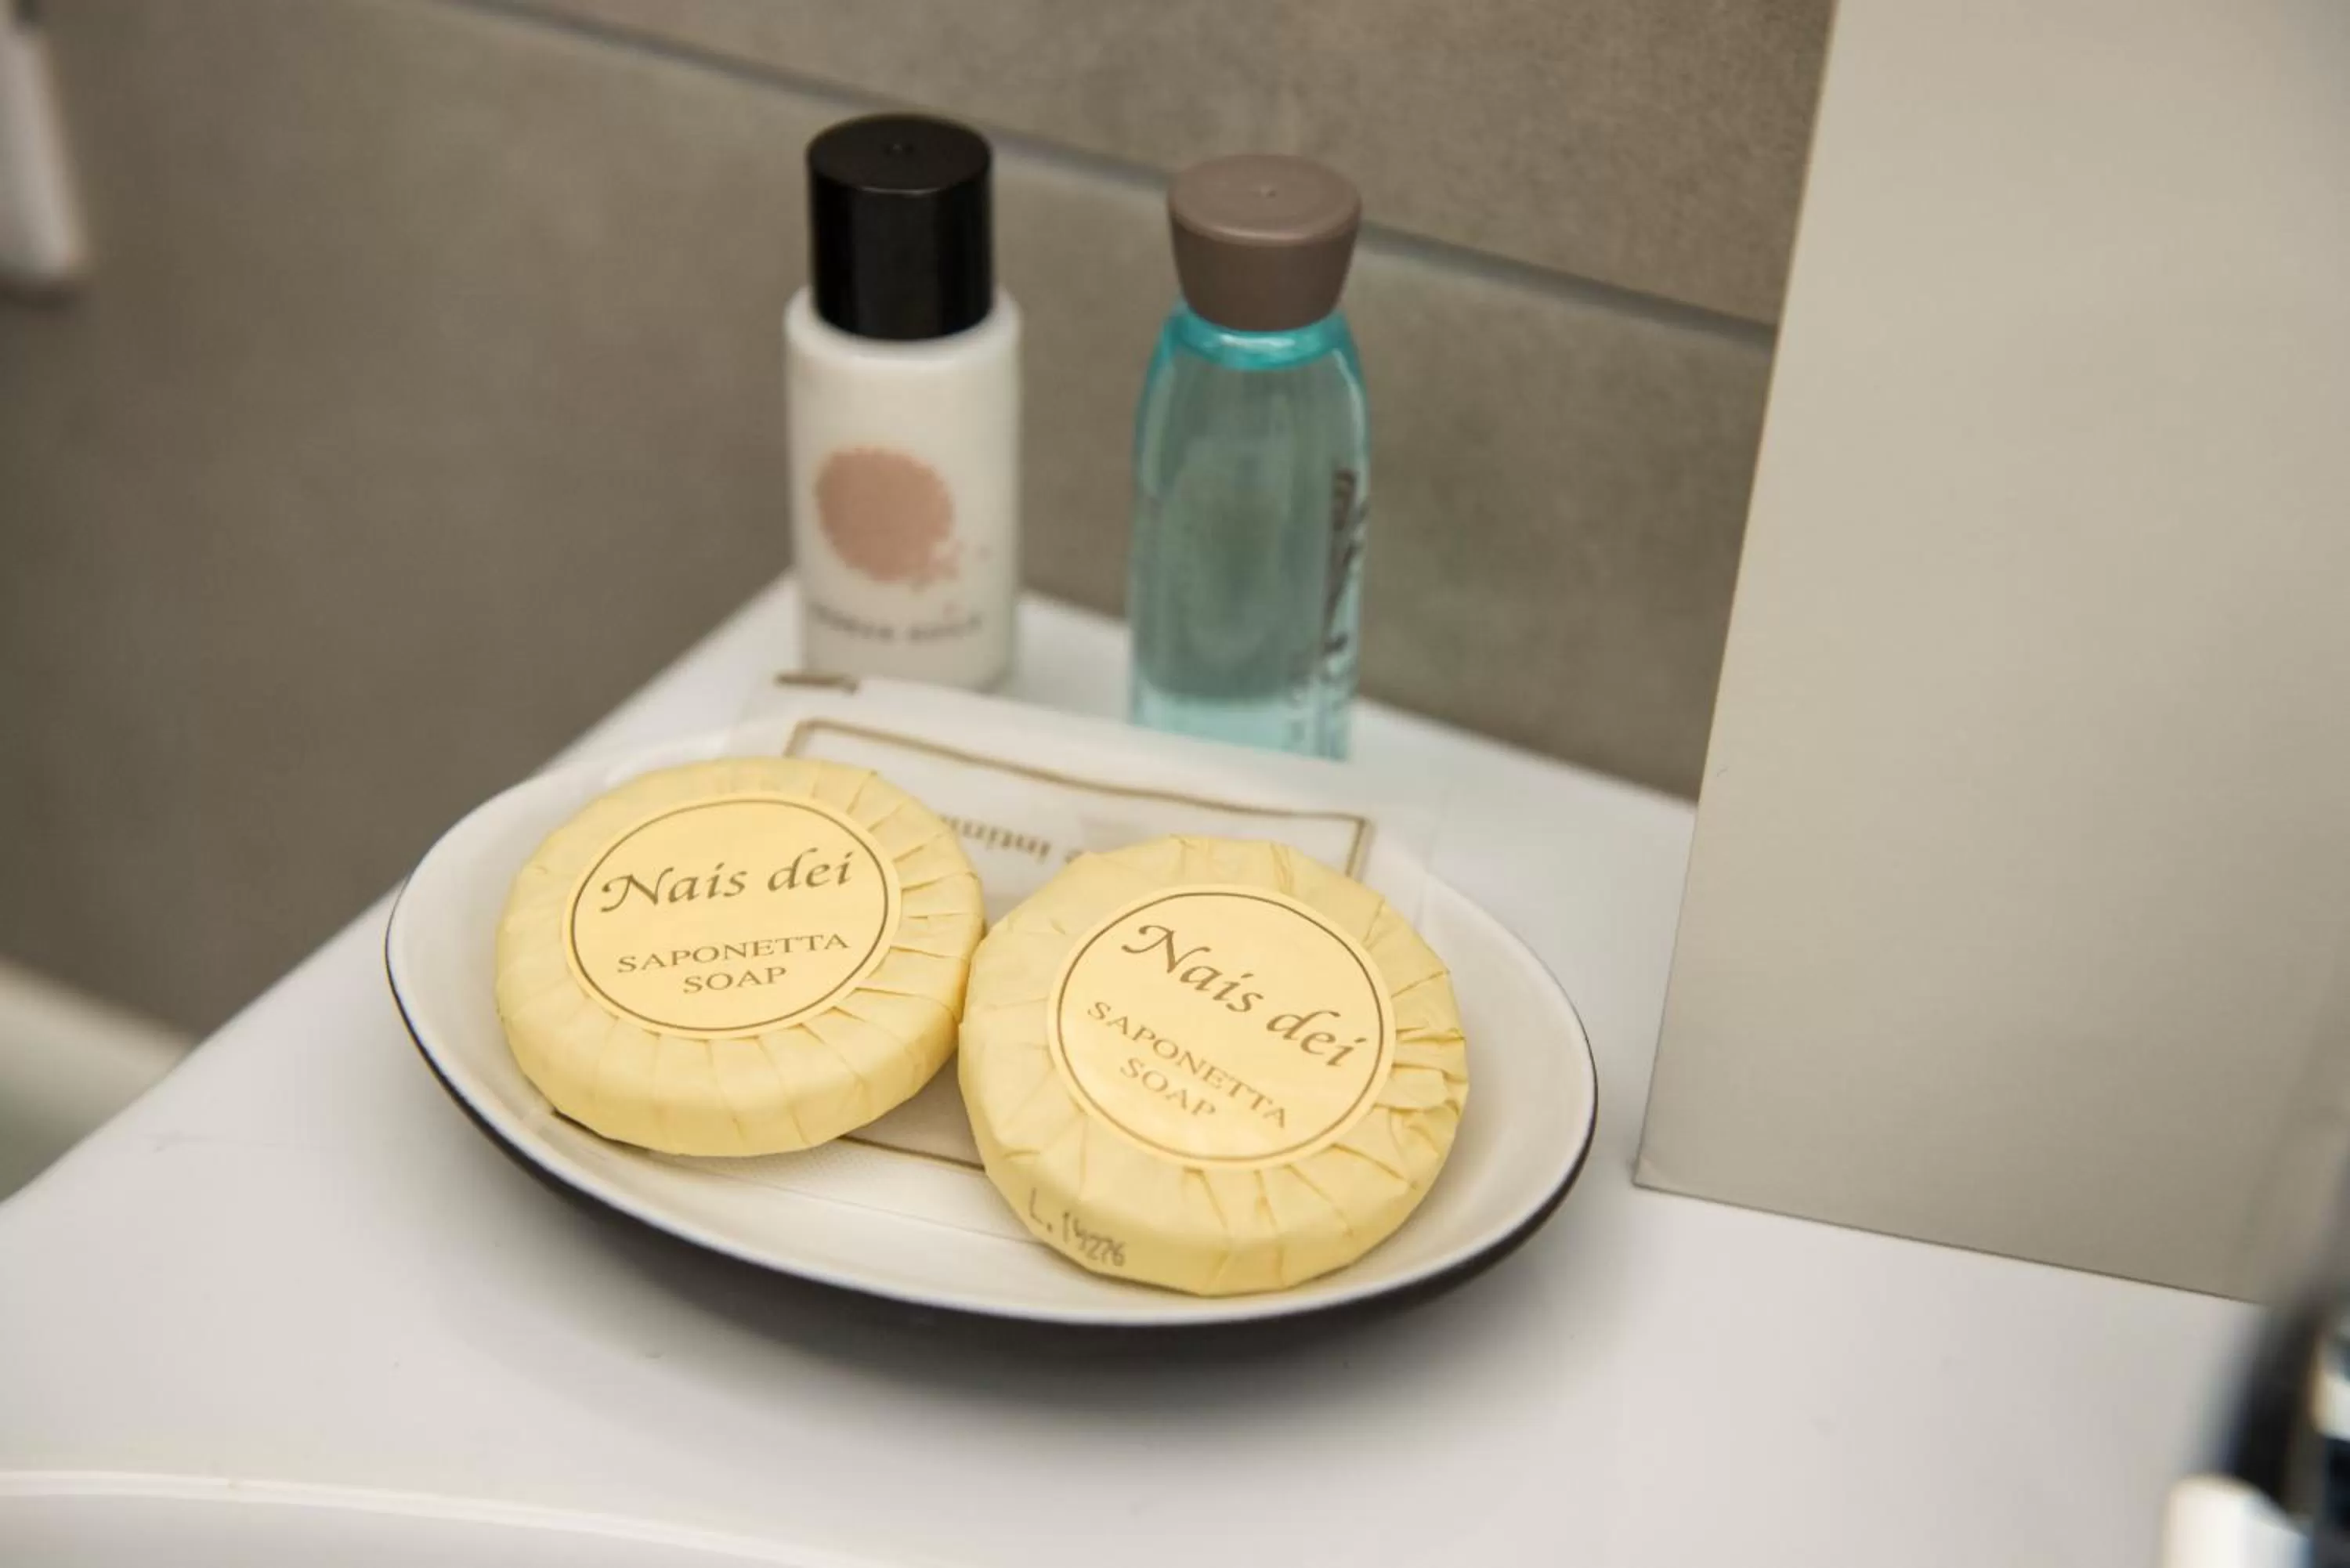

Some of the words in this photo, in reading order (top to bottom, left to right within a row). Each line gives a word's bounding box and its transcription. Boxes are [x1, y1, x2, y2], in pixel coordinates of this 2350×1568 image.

[601, 862, 748, 912] Nais
[767, 847, 853, 893] dei
[616, 933, 851, 974] SAPONETTA
[682, 966, 787, 994] SOAP
[1121, 924, 1264, 1013] Nais
[1266, 1010, 1367, 1068] dei
[1086, 1001, 1287, 1129] SAPONETTA
[1119, 1057, 1217, 1117] SOAP
